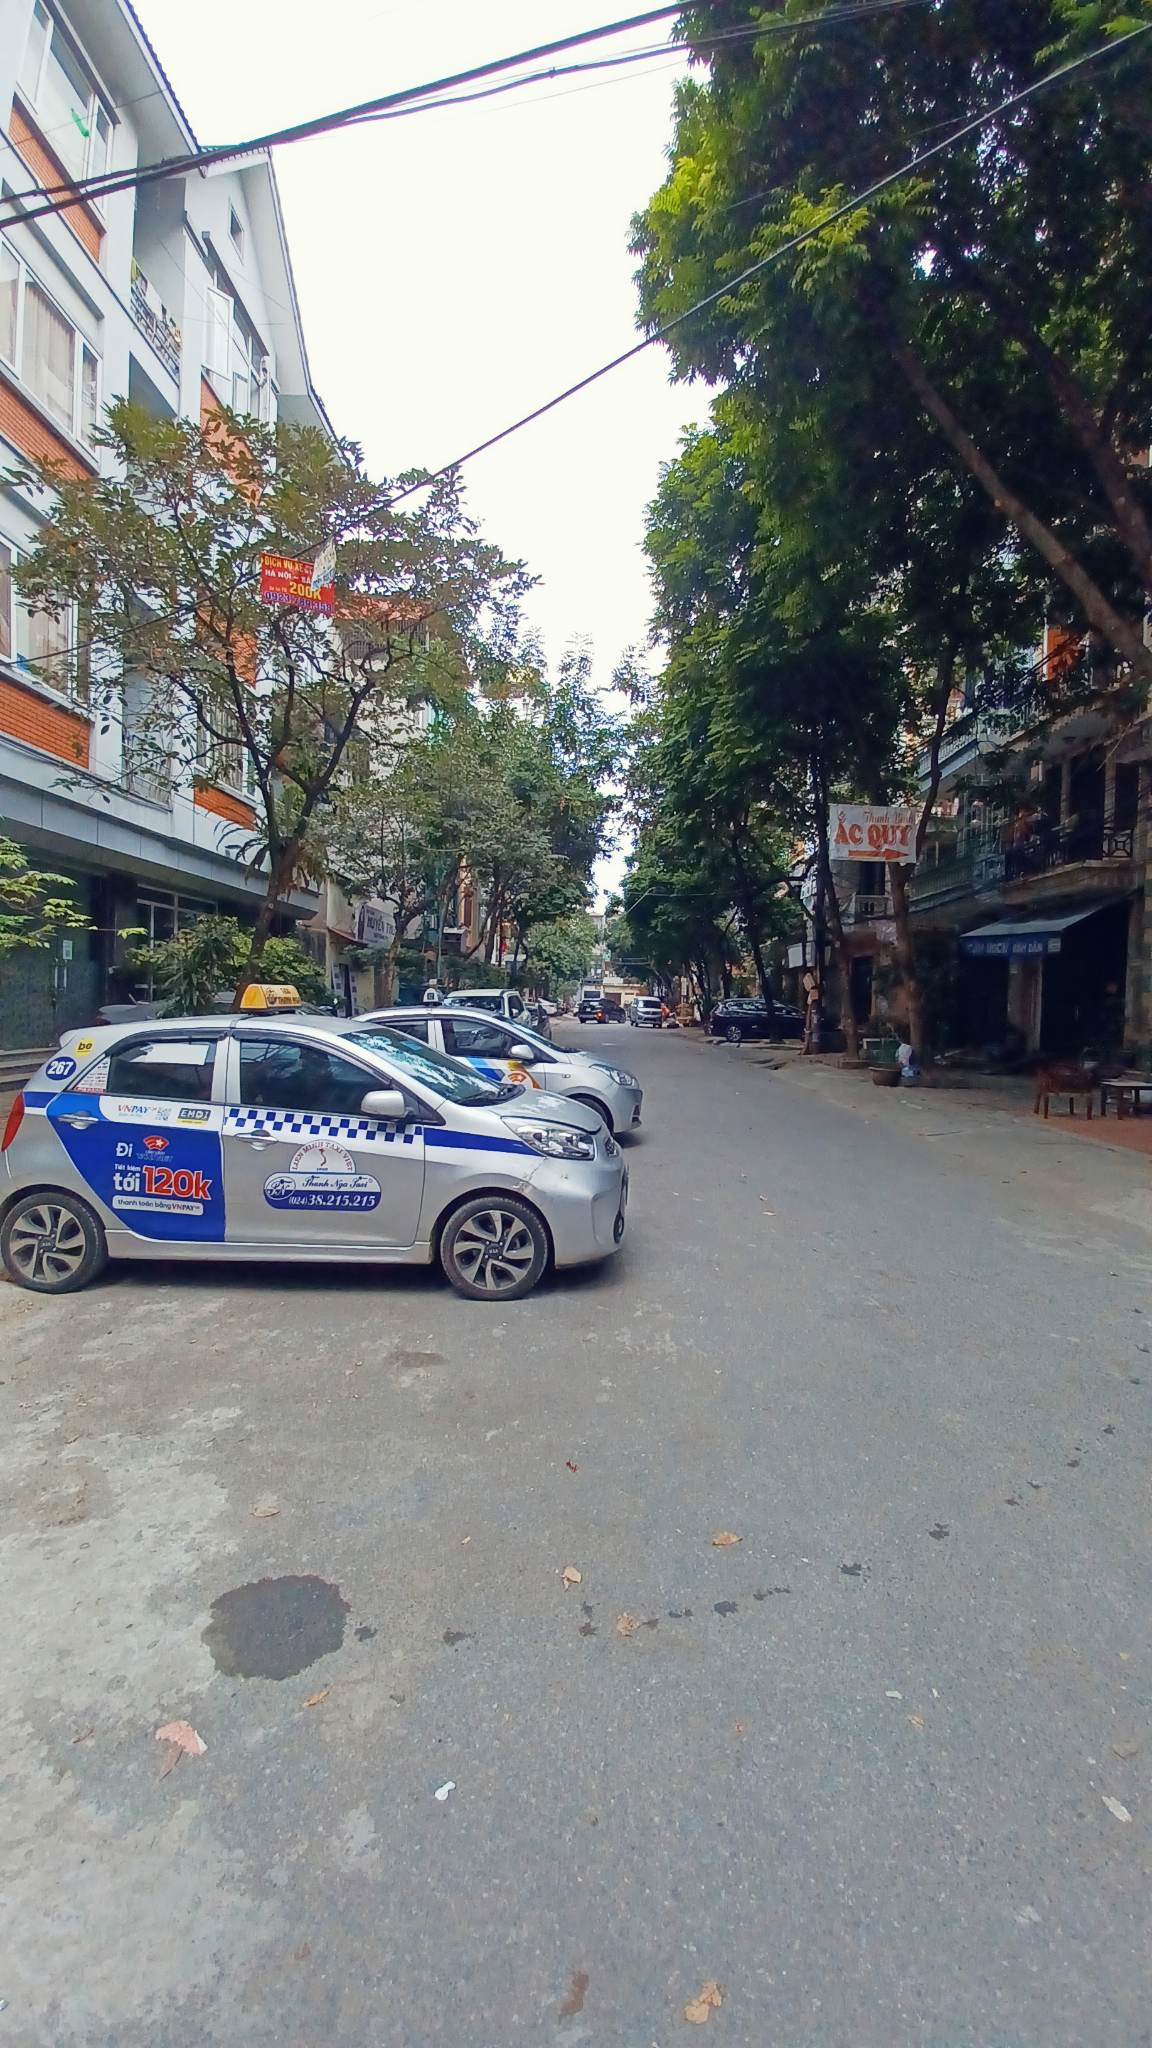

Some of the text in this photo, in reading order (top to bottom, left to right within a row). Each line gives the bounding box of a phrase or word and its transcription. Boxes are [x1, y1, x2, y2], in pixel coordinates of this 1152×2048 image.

[47, 1060, 74, 1076] 267
[179, 1108, 211, 1120] EMDI
[116, 1142, 133, 1158] Đi
[113, 1164, 213, 1201] tới 120k
